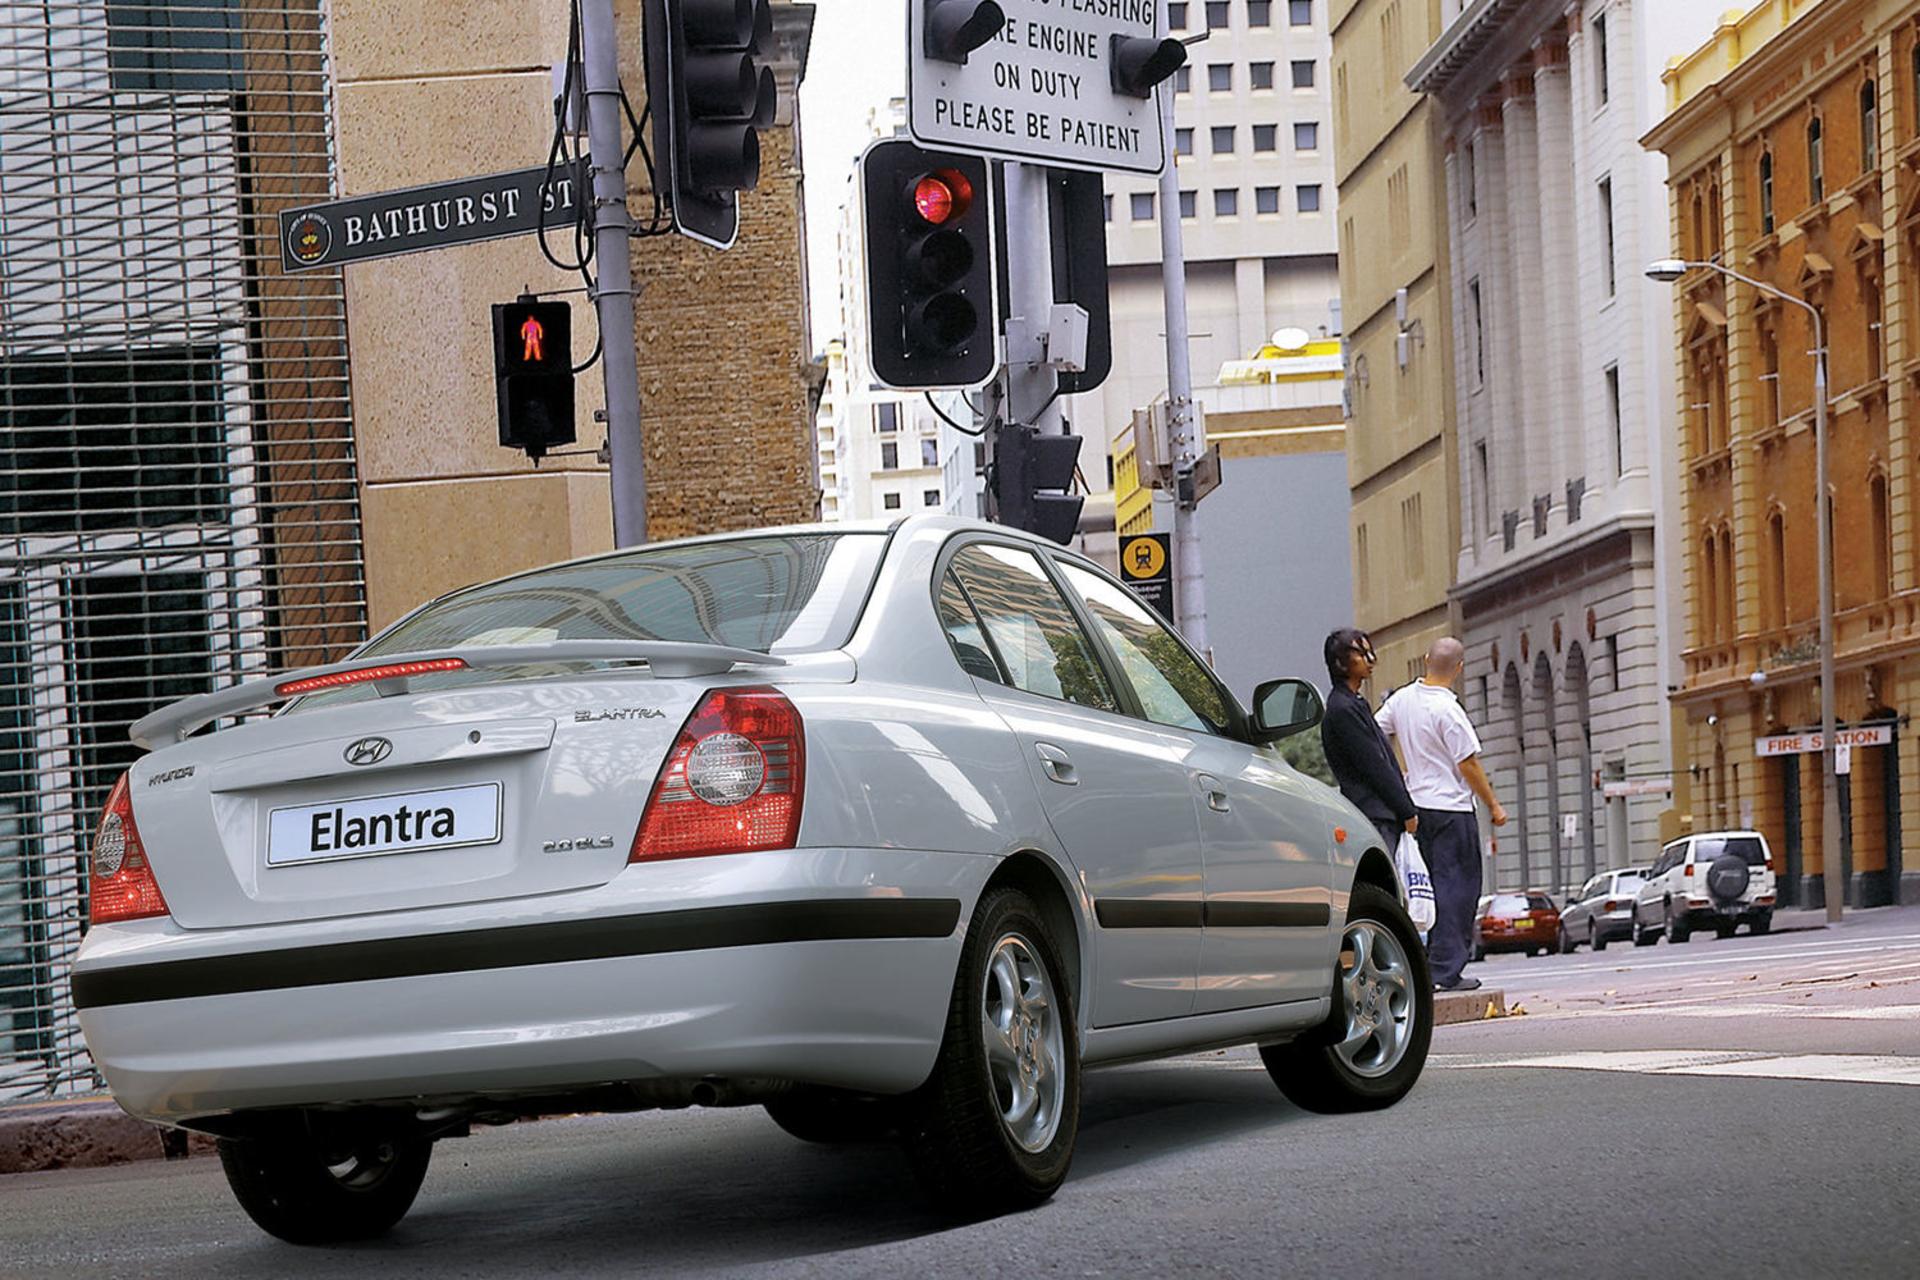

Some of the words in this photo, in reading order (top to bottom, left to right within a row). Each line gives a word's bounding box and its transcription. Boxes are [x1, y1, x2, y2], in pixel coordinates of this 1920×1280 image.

[1061, 0, 1152, 25] LASHING
[1028, 22, 1098, 59] ENGINE
[994, 62, 1020, 90] ON
[1031, 68, 1081, 100] DUTY
[935, 98, 1016, 134] PLEASE
[1027, 112, 1050, 139] BE
[1061, 118, 1140, 153] PATIENT
[344, 188, 519, 246] BATHURST
[538, 179, 573, 212] ST
[575, 707, 666, 722] ELANTRA
[1767, 737, 1802, 752] FIRE
[1811, 730, 1878, 749] SATION
[311, 805, 455, 852] Elantra
